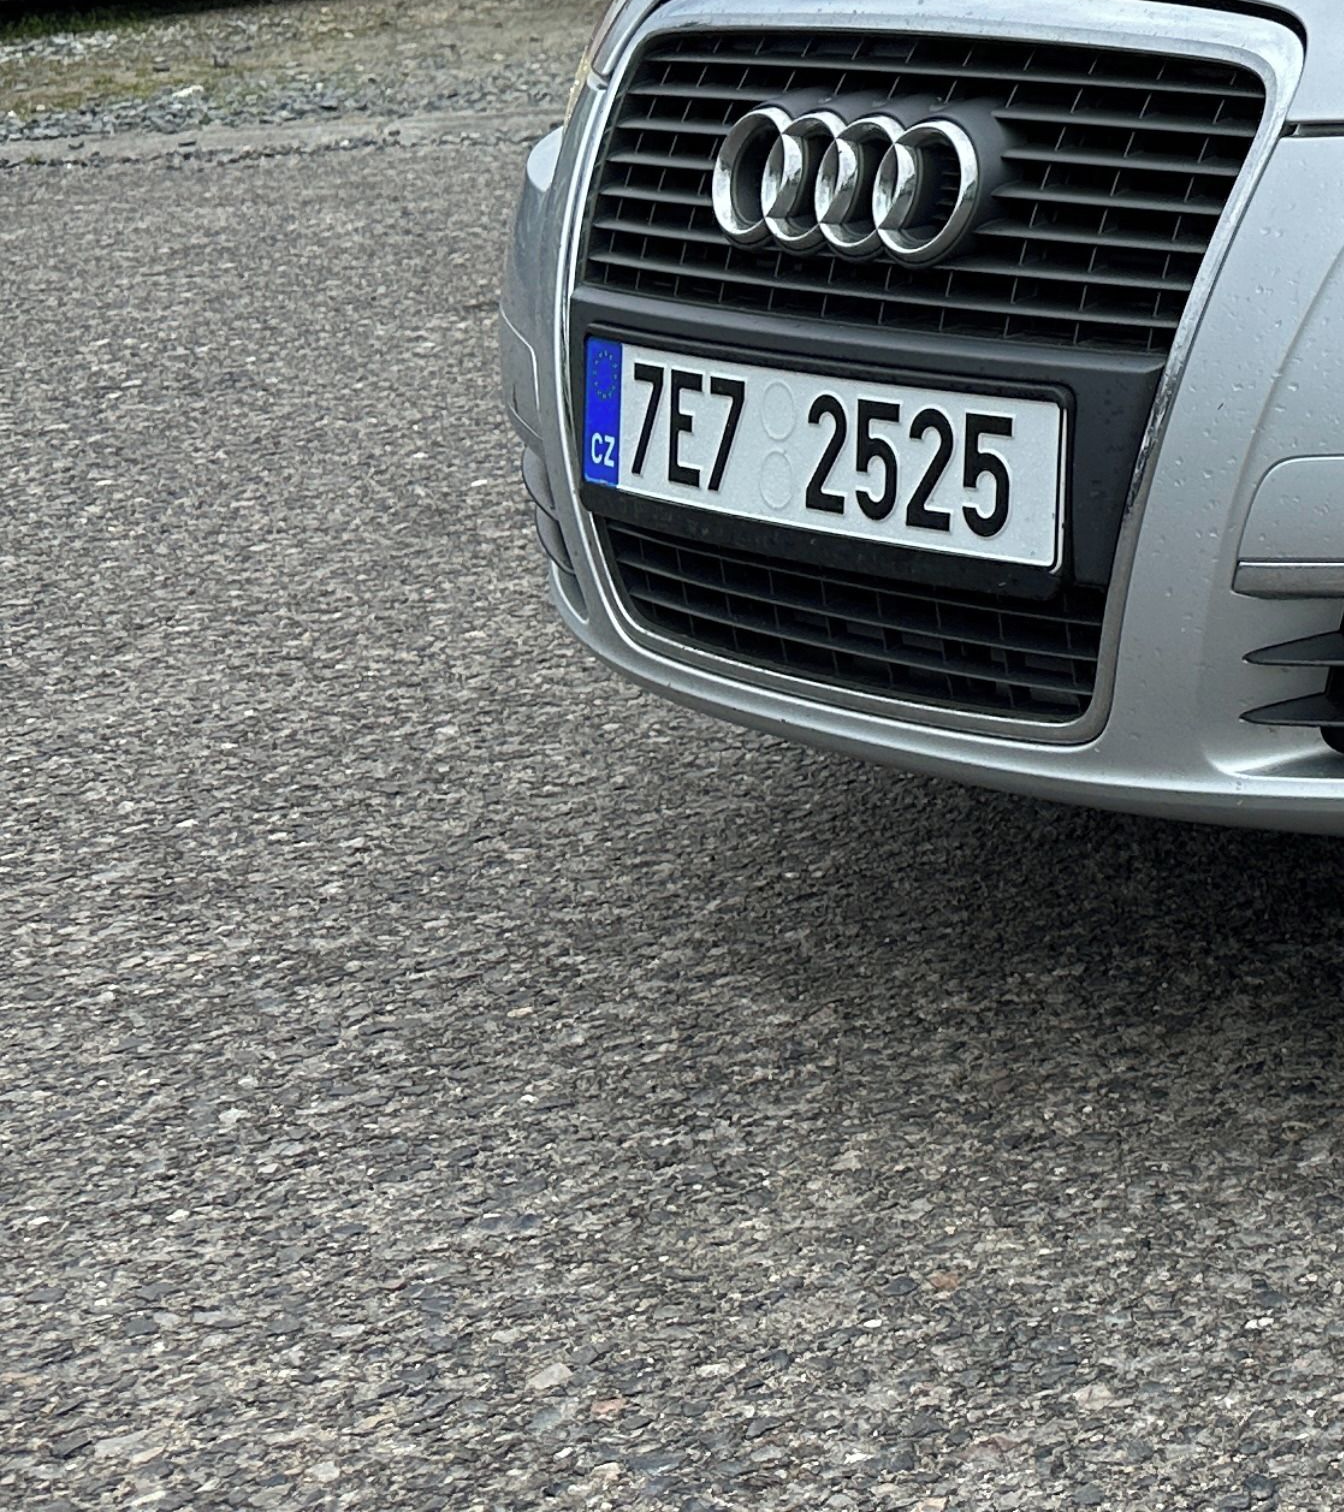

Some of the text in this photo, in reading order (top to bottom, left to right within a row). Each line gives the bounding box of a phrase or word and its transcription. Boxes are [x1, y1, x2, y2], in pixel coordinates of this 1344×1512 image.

[591, 431, 616, 468] CZ
[631, 361, 1014, 538] 7E7 2525
